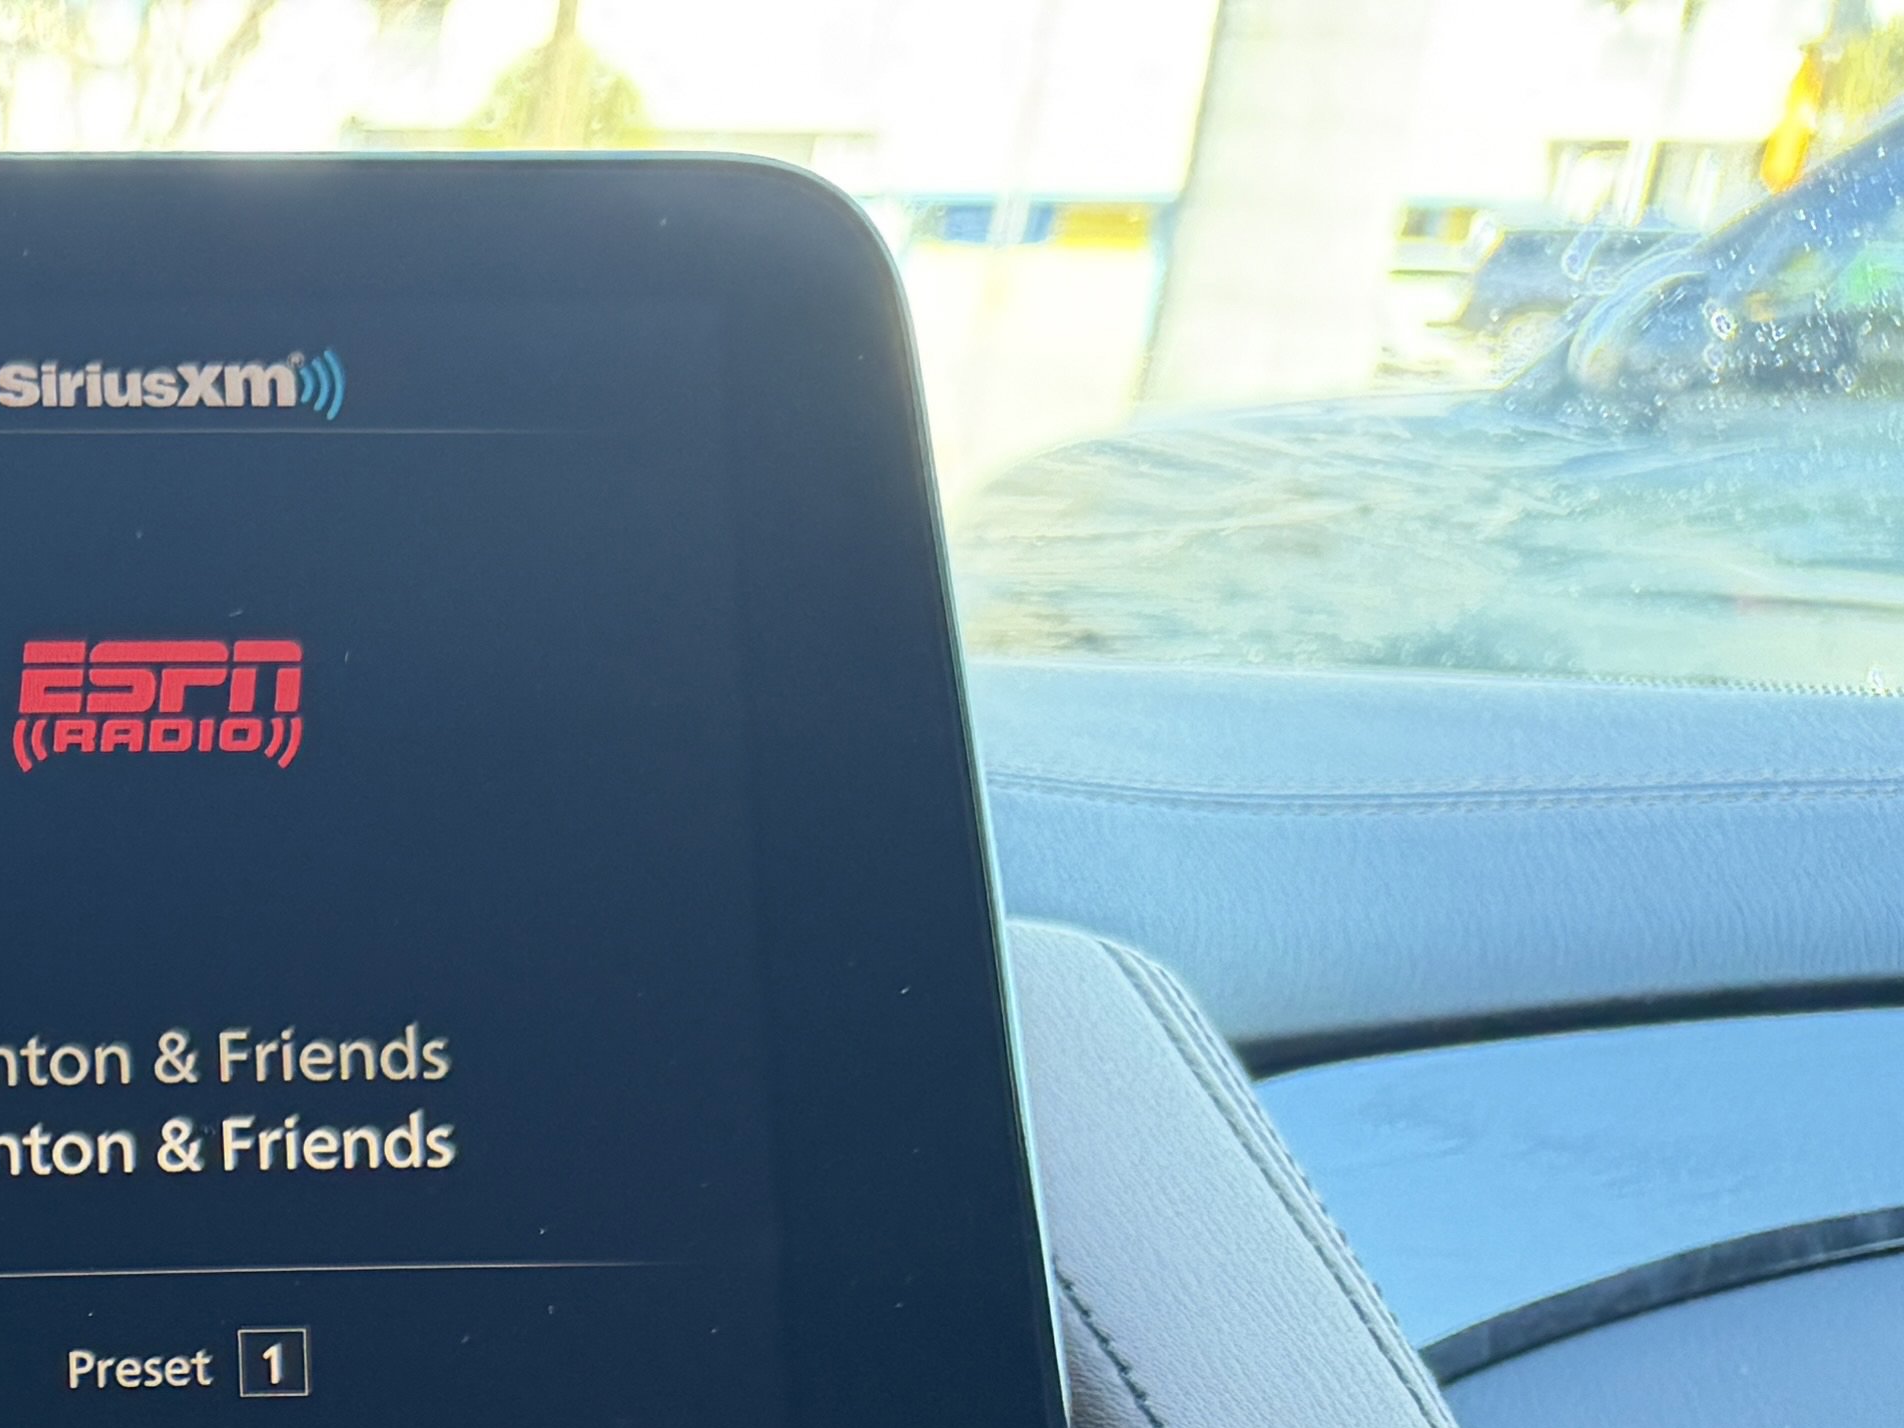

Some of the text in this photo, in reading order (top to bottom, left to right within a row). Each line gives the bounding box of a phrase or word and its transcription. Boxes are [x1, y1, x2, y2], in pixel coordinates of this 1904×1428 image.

[17, 638, 304, 714] ESPN
[51, 717, 264, 754] RADIO
[153, 1025, 201, 1085] &
[218, 1020, 453, 1084] Friends
[157, 1114, 206, 1174] &
[220, 1107, 459, 1172] Friends
[67, 1341, 287, 1389] Preset 1
